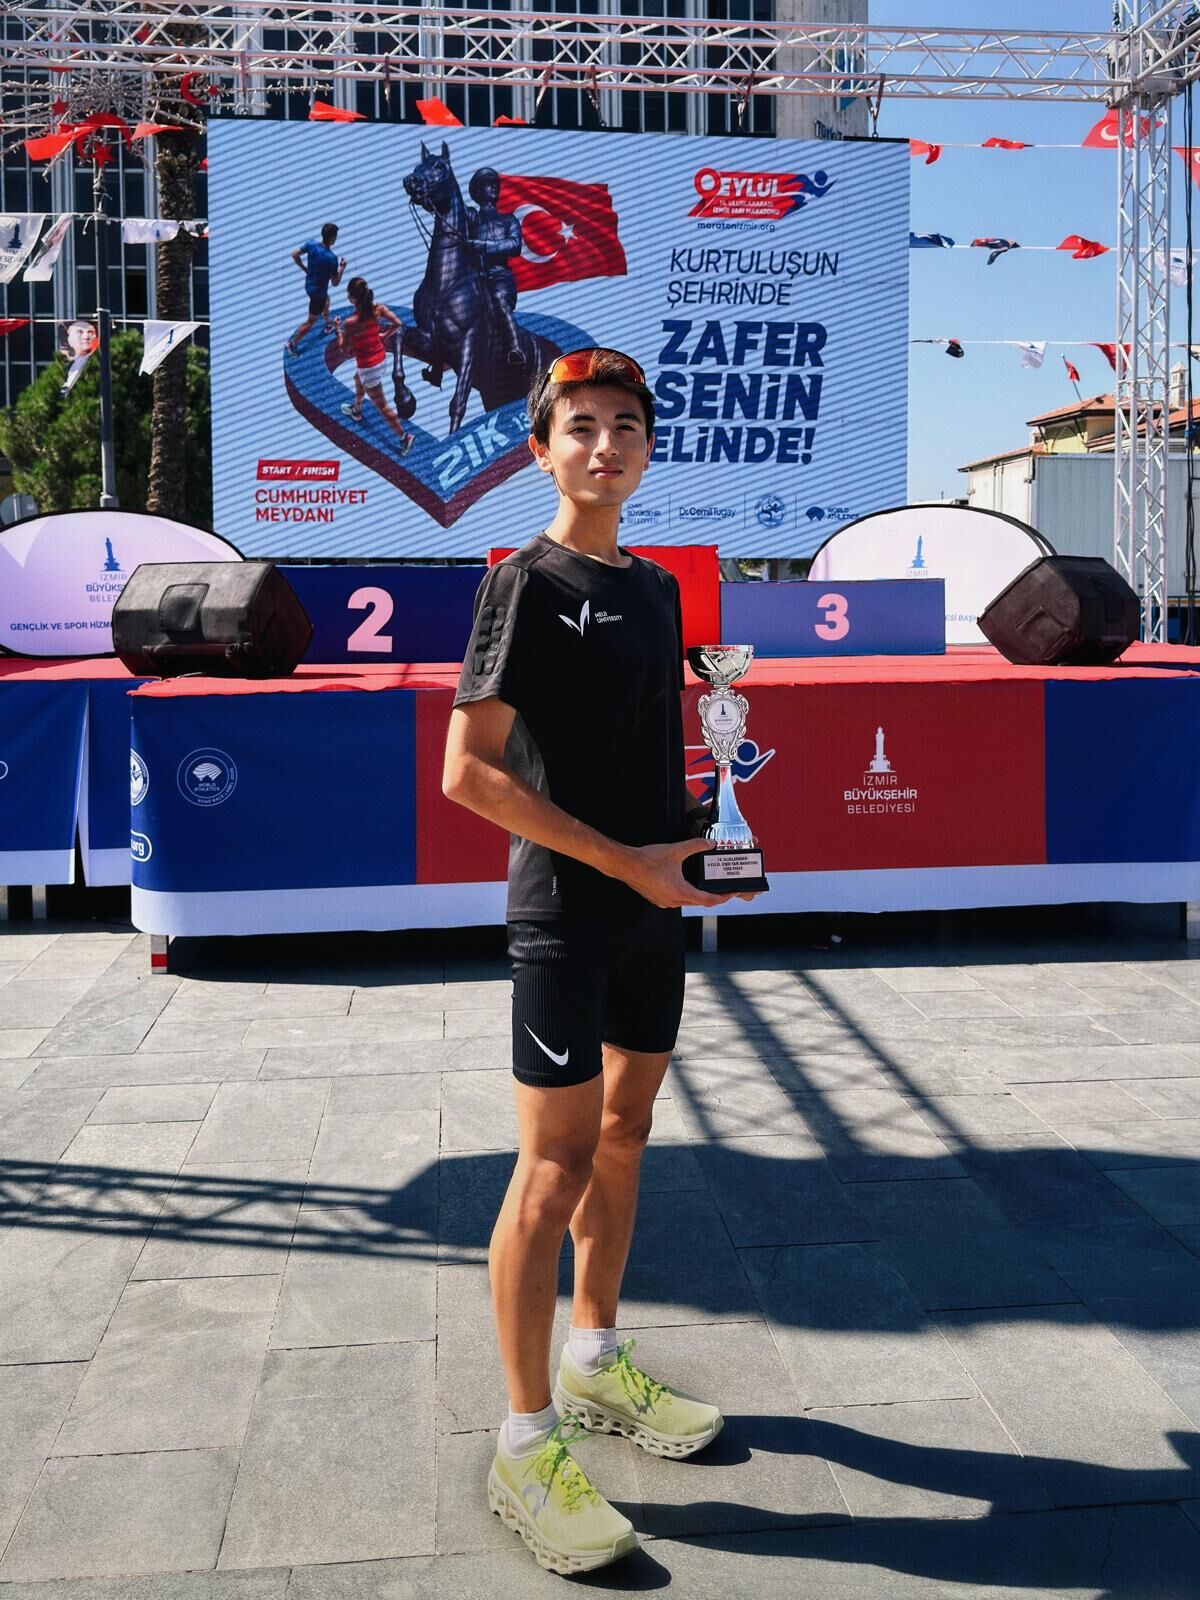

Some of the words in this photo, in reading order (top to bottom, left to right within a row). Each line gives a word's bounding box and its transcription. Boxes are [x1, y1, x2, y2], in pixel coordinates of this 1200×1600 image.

[719, 177, 779, 197] EYLÜL
[697, 222, 776, 232] maratonizmir.org
[670, 248, 840, 279] KURTULUŞUN
[667, 277, 793, 308] ŞEHRİNDE
[658, 319, 828, 367] ZAFER
[262, 465, 292, 475] START
[302, 466, 336, 476] FINISH
[255, 486, 368, 504] CUMHURİYET
[255, 508, 334, 523] MEYDANI
[346, 587, 394, 653] 2
[814, 593, 850, 641] 3
[10, 622, 49, 632] GENÇLİK
[64, 622, 88, 630] SPOR
[863, 774, 898, 786] İZMİR
[844, 787, 918, 800] BÜYÜKŞEHİR
[847, 802, 915, 814] BELEDİYESİ
